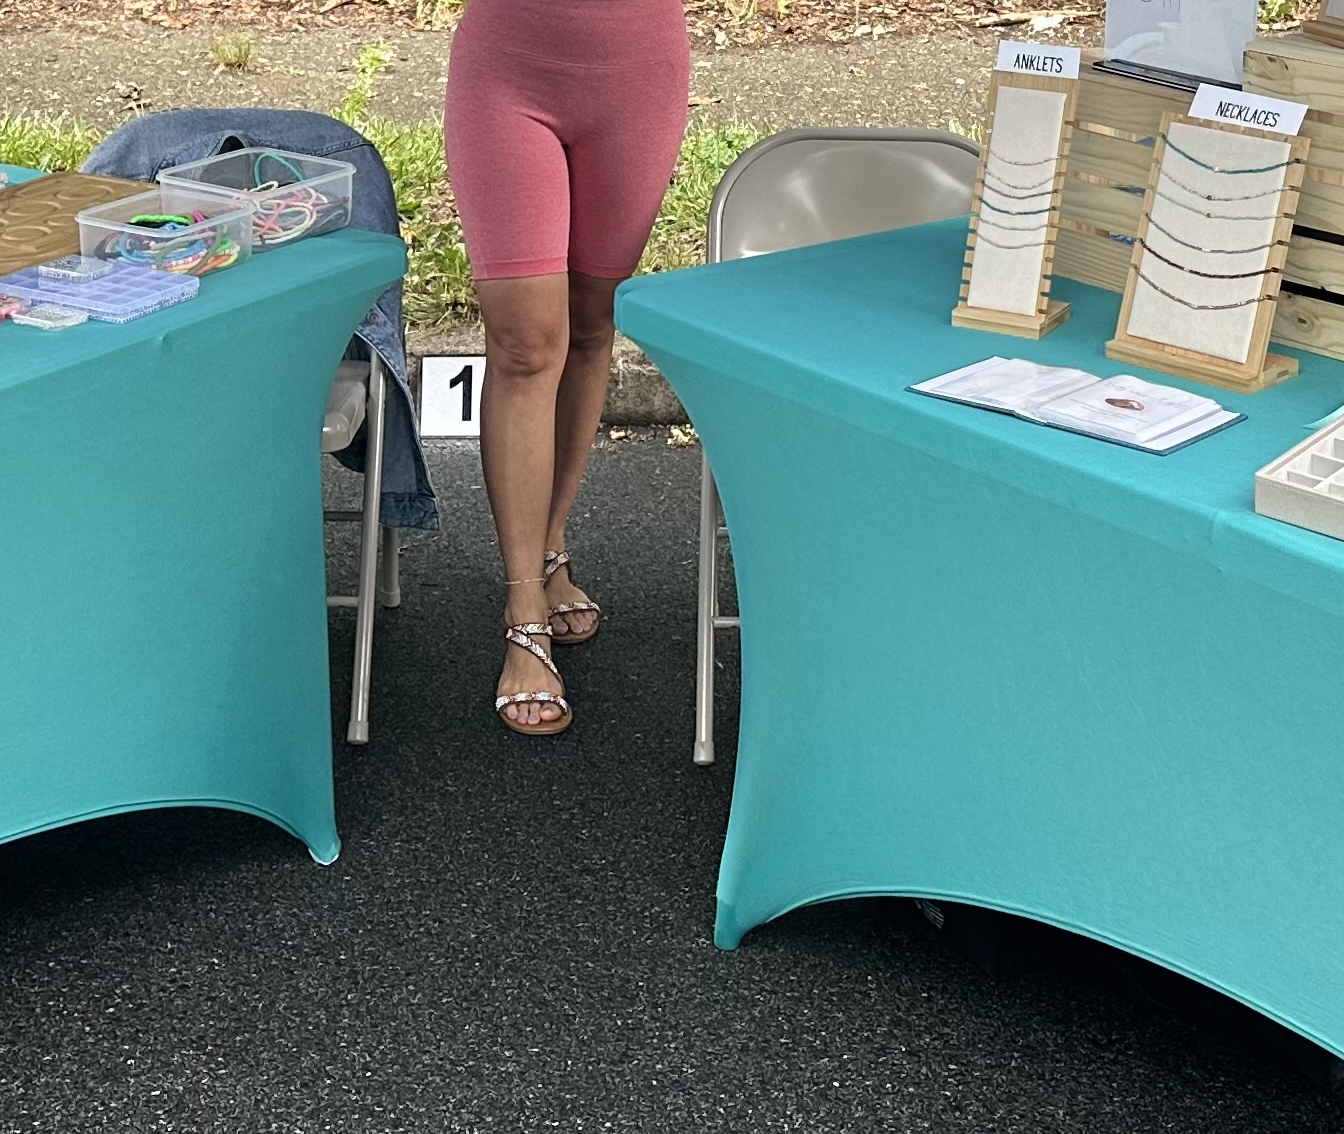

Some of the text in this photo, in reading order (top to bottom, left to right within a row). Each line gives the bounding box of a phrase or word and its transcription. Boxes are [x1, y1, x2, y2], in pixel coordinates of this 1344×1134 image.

[1013, 53, 1063, 74] ANKLETS
[1215, 101, 1280, 128] NECKLACES
[449, 365, 473, 421] 1
